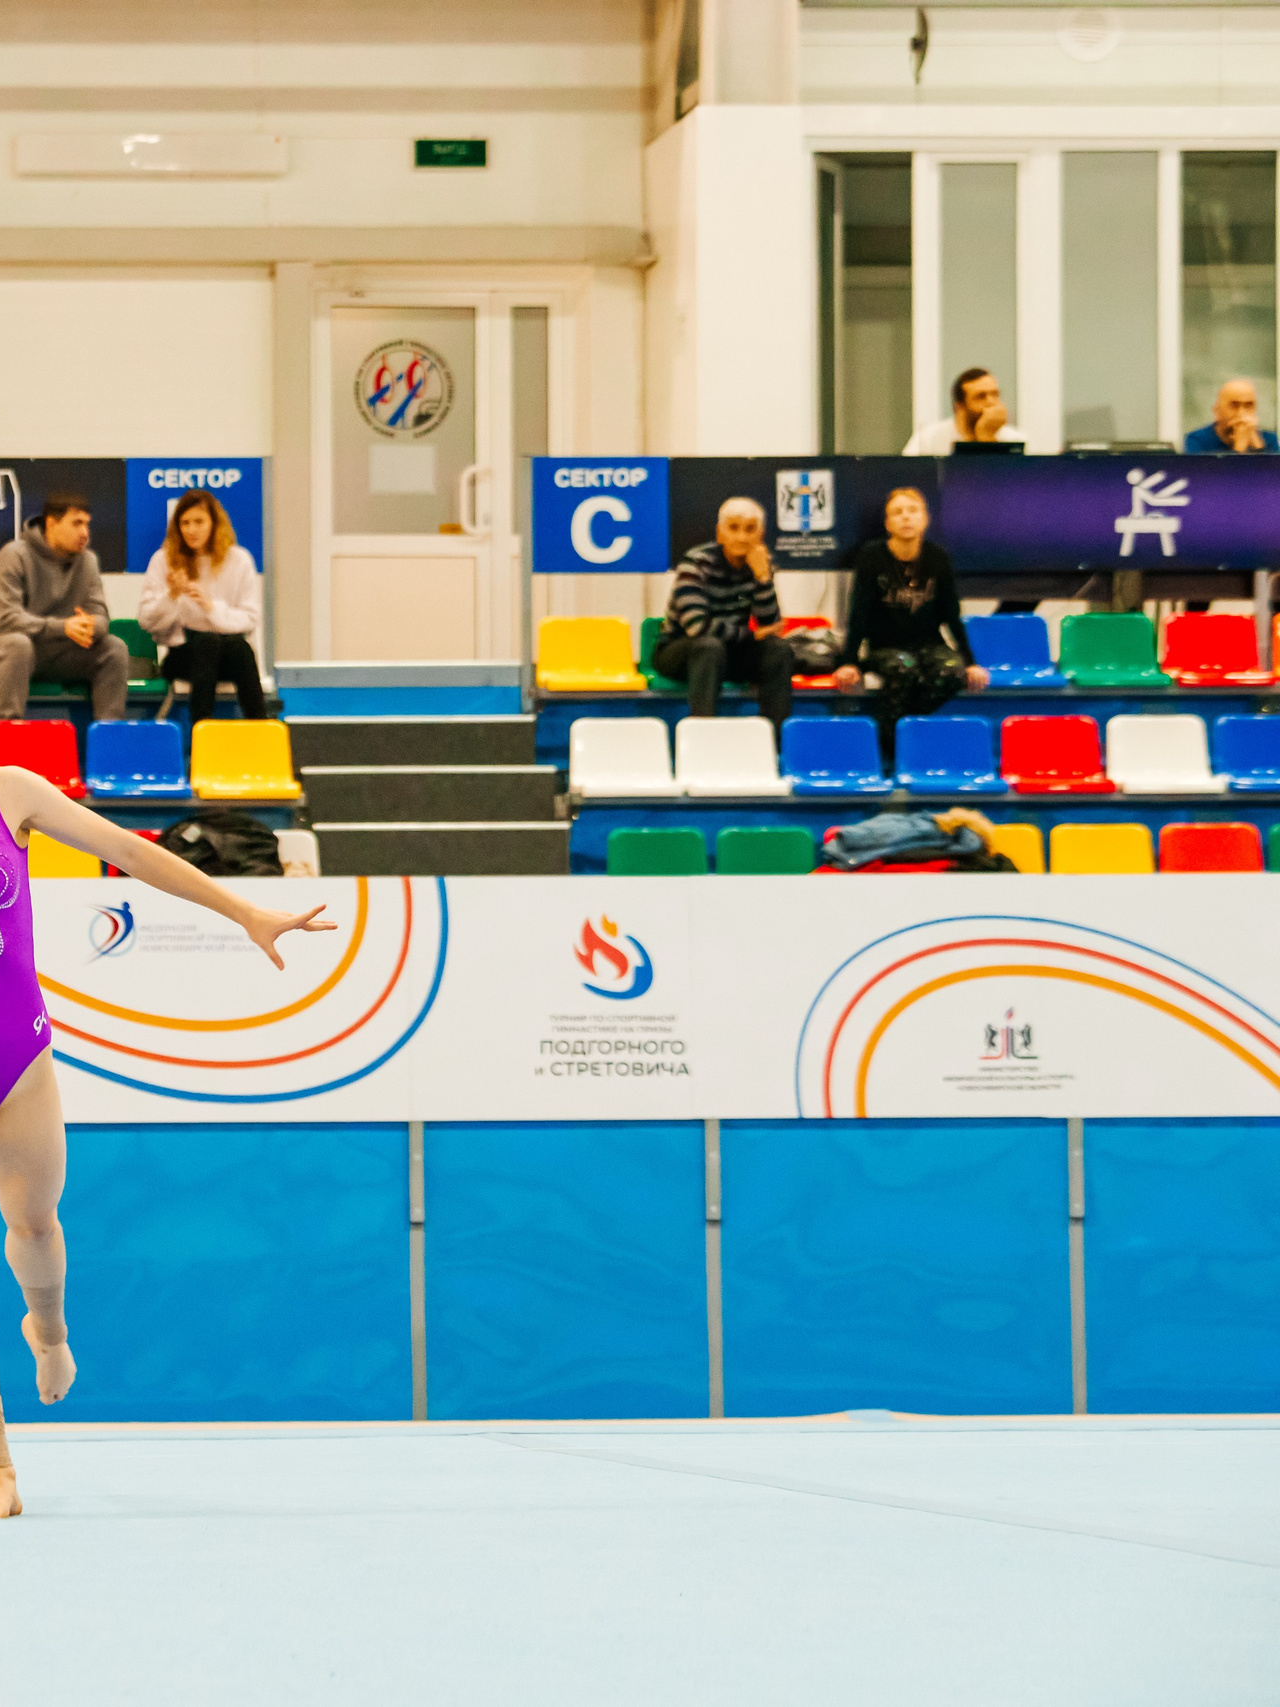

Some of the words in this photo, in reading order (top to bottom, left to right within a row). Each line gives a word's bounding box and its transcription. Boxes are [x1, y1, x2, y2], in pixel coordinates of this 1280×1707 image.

[148, 468, 242, 489] СЕКТОР
[554, 467, 648, 488] СЕКТОР
[540, 1040, 685, 1056] ПОДГОРНОГО
[550, 1061, 690, 1077] СТРЕТОВИЧА
